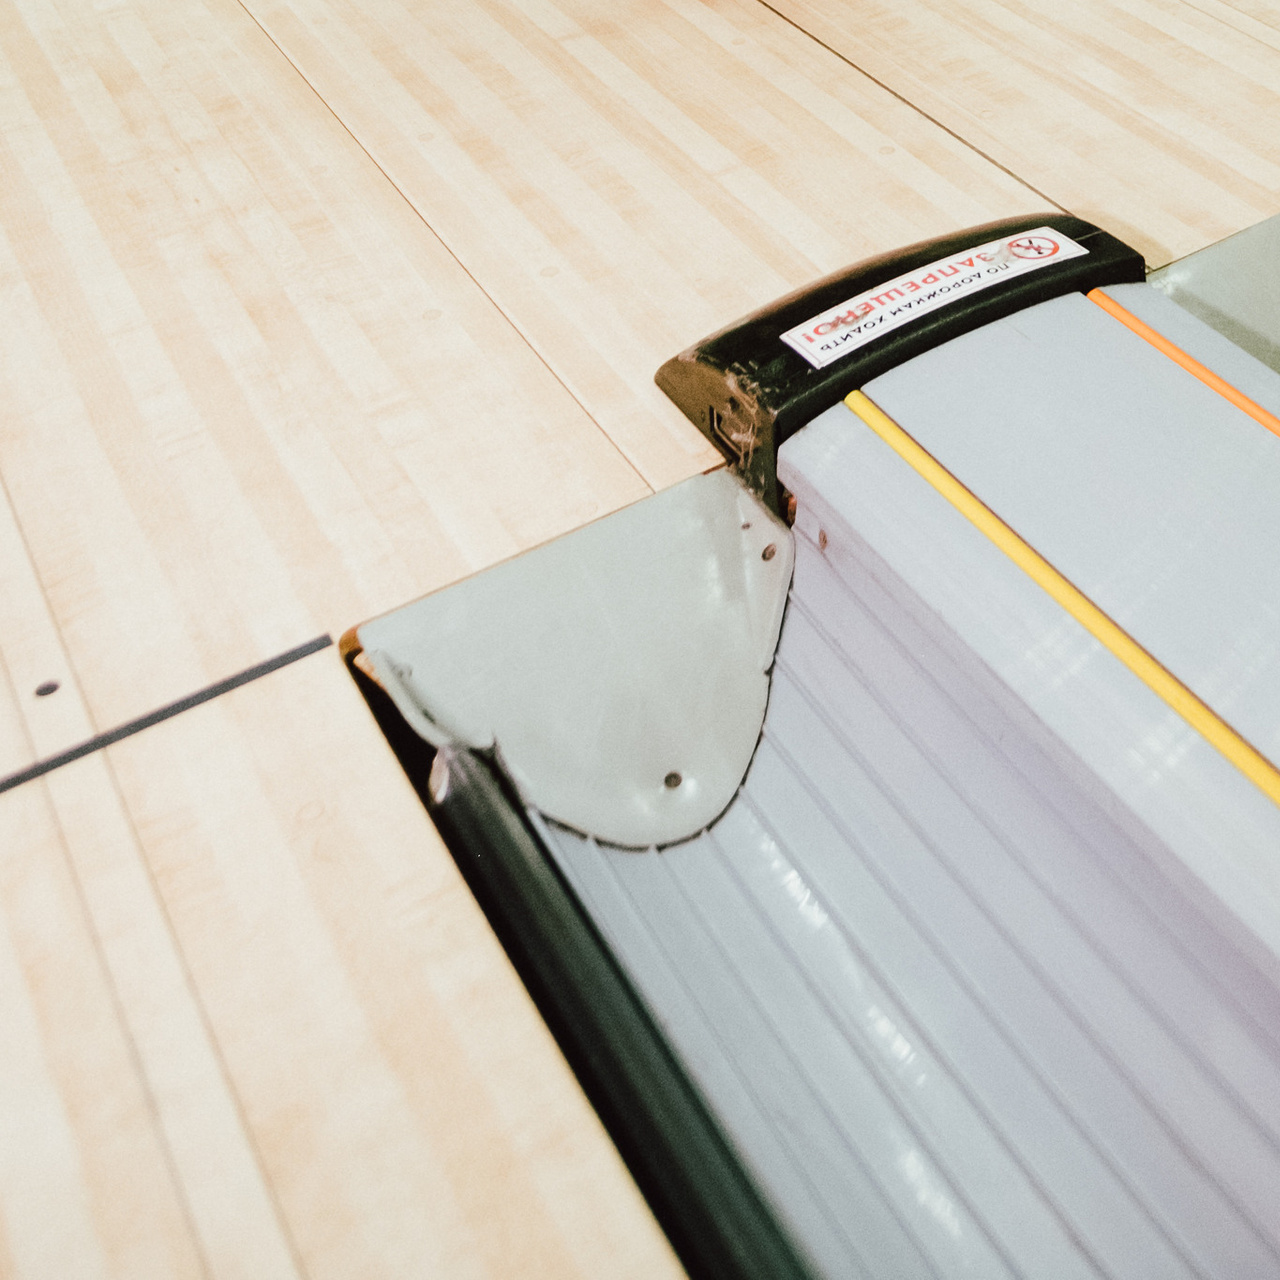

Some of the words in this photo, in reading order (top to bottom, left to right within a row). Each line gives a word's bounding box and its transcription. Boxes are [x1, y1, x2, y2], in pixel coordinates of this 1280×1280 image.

[985, 261, 1010, 276] ПО
[890, 270, 982, 317] ДОРОЖКАМ
[820, 314, 891, 352] ХОДИТЬ
